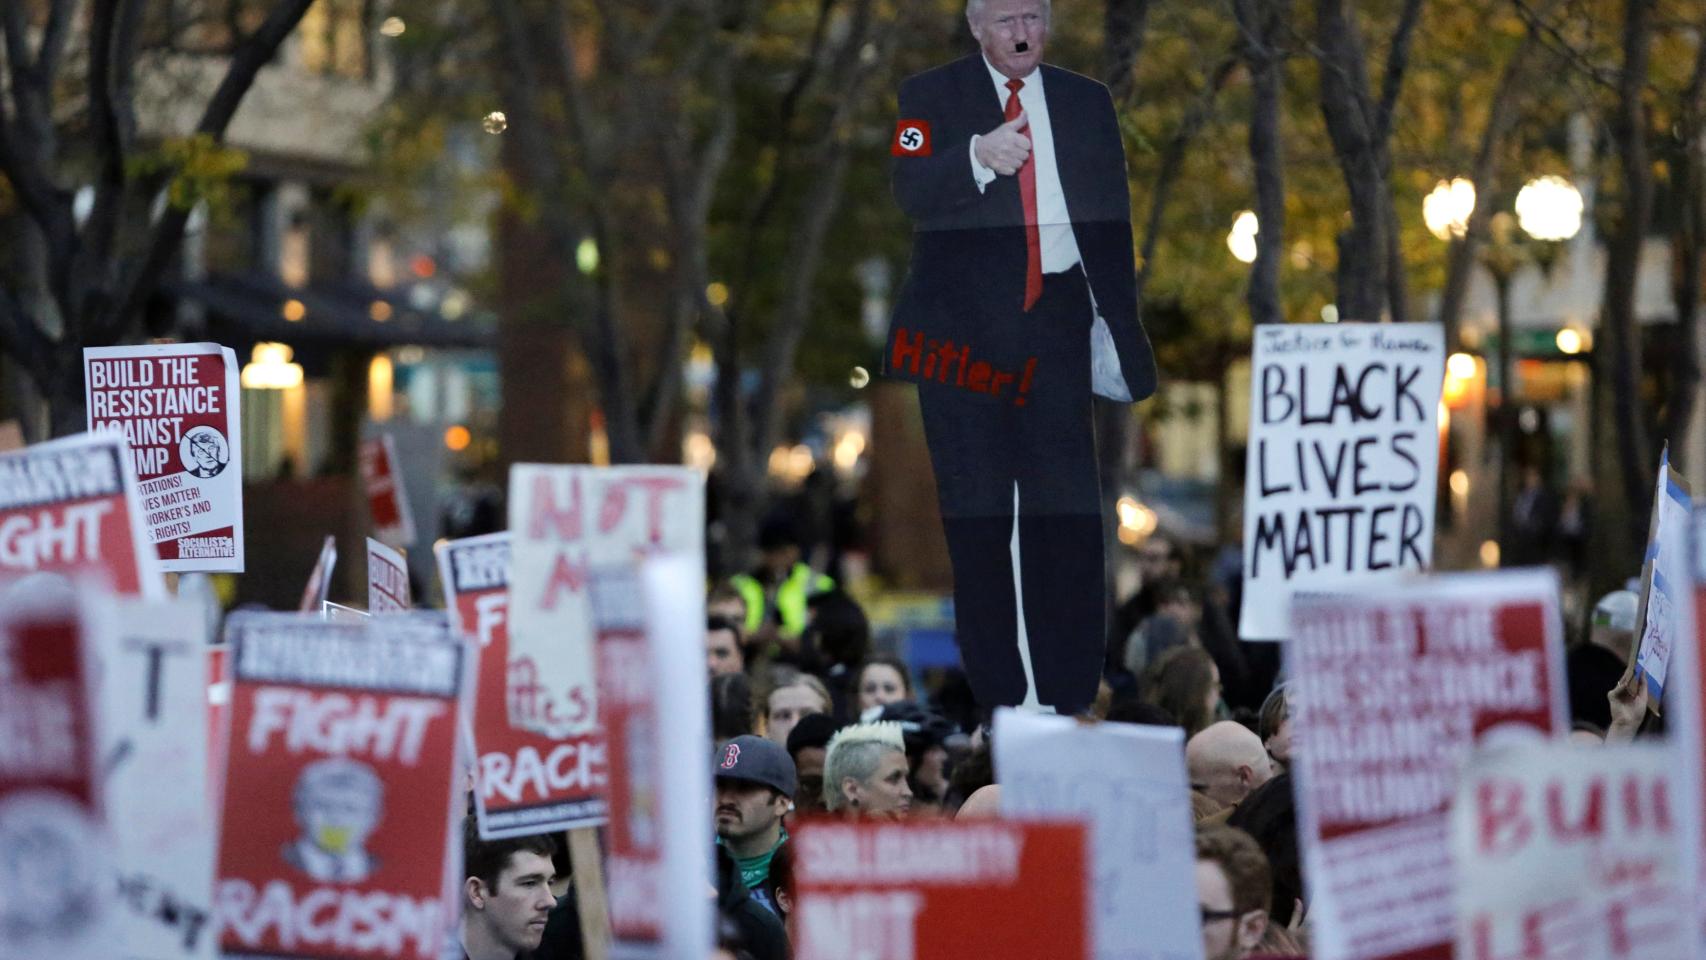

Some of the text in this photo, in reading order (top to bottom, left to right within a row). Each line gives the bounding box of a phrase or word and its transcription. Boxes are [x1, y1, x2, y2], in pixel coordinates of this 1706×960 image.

[91, 356, 199, 389] BUILD THE
[890, 327, 1038, 407] Hitler!
[93, 386, 220, 418] RESISTANCE
[1262, 363, 1425, 426] BLACK
[1259, 432, 1420, 500] LIVES
[161, 487, 201, 508] MATTER!
[192, 500, 212, 516] AND
[155, 521, 192, 540] RIGHTS!
[1251, 503, 1424, 579] MATTER
[247, 686, 445, 765] FIGHT
[721, 744, 740, 769] B
[216, 879, 443, 958] RACISM
